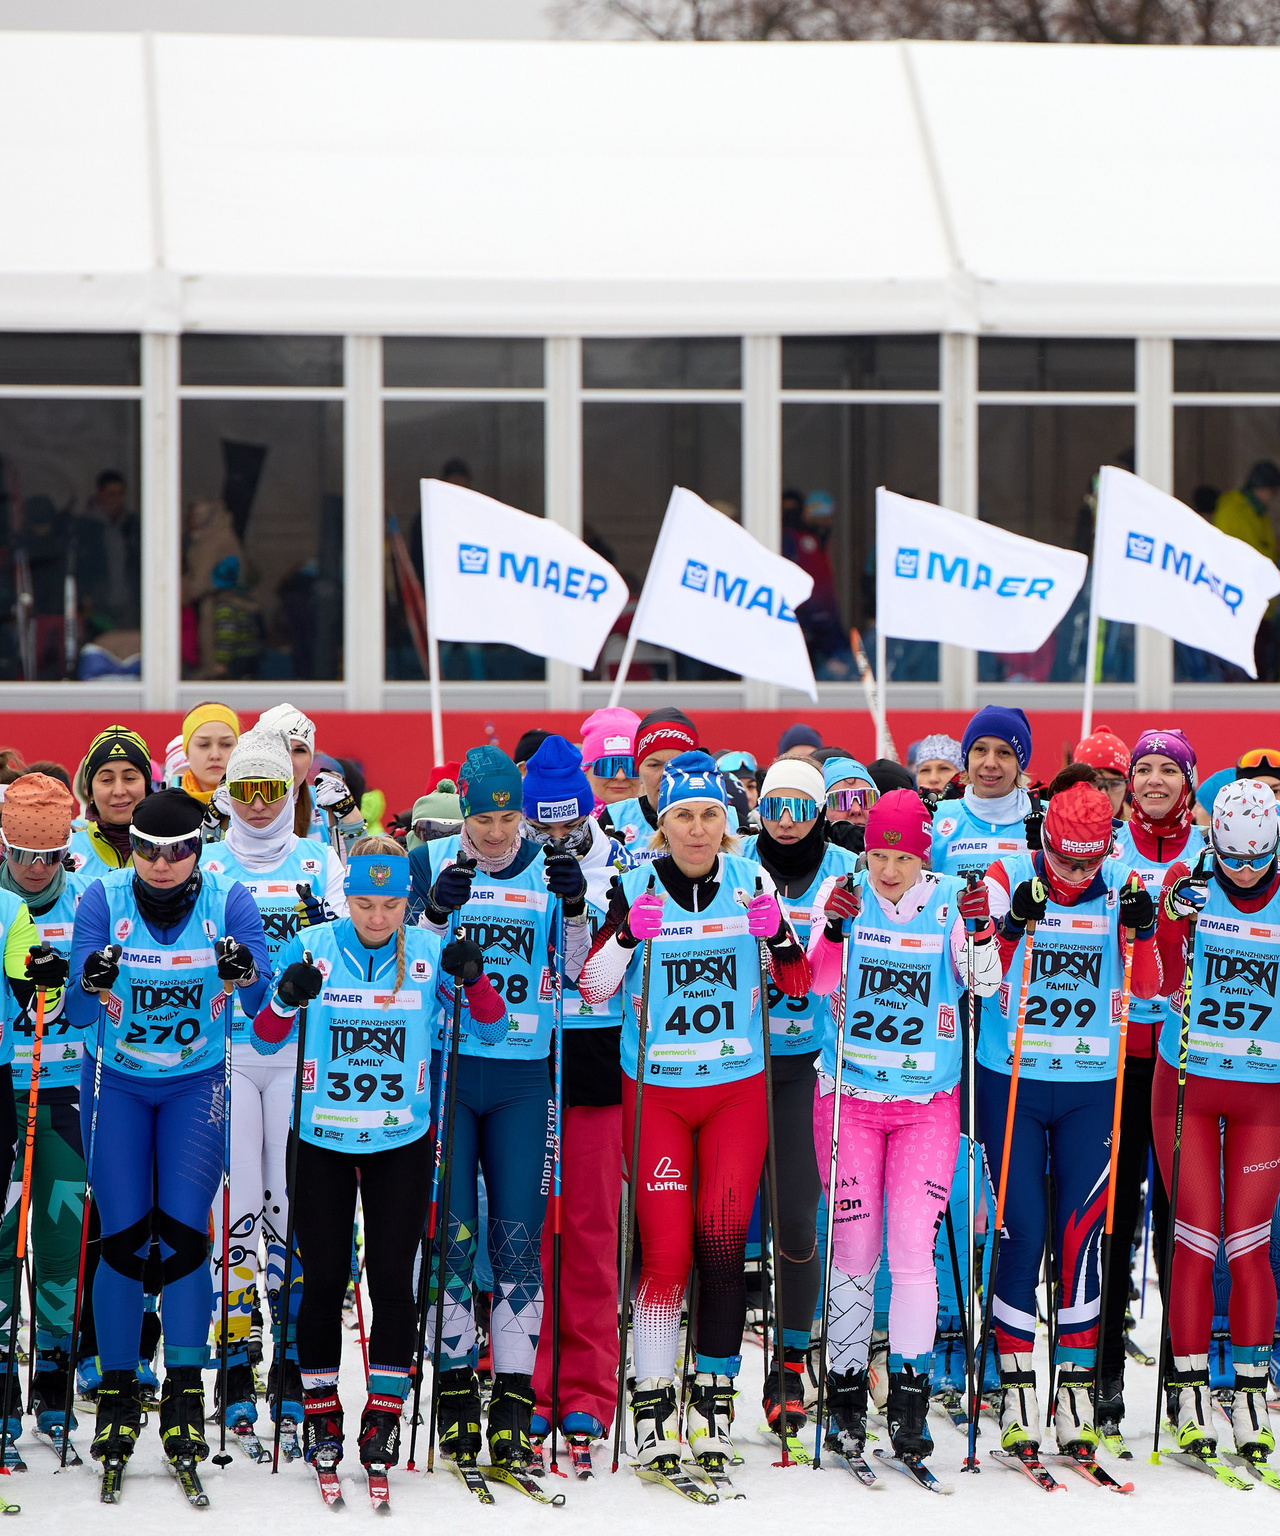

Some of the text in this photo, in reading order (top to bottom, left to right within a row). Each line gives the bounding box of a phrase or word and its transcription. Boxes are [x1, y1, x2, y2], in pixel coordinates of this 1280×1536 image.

[500, 552, 607, 602] MAER
[928, 551, 1054, 600] MAER
[714, 570, 798, 624] MAE
[552, 804, 576, 813] СПОРТ
[957, 842, 988, 851] MAER
[487, 916, 535, 926] PANZHINSKIY
[1208, 921, 1239, 933] MAER
[660, 927, 693, 936] MAER
[461, 922, 534, 965] TOPSKI
[863, 932, 891, 944] MAER
[692, 947, 736, 957] PANZHINSKIY
[1205, 945, 1220, 953] TEAM
[1234, 950, 1280, 961] PANZHINSKIY
[130, 955, 161, 963] MAER
[889, 959, 931, 970] PANZHINSKIY
[1031, 949, 1102, 988] TOPSKI
[160, 977, 204, 985] PANZHINSKIY
[662, 955, 737, 998] TOPSKI
[1203, 952, 1279, 999] TOPSKI
[859, 964, 931, 1008] TOPSKI
[1046, 982, 1079, 992] FAMILY
[1220, 986, 1253, 996] FAMILY
[130, 984, 204, 1014] TOPSKI
[330, 994, 362, 1003] MAER
[683, 988, 717, 999] FAMILY
[874, 998, 908, 1010] FAMILY
[147, 1011, 180, 1021] FAMILY
[1025, 995, 1096, 1028] 299
[1197, 998, 1272, 1032] 257
[665, 1001, 735, 1036] 401
[125, 1018, 200, 1045] 270
[850, 1011, 924, 1045] 262
[329, 1025, 406, 1063] TOPSKI
[653, 1048, 696, 1056] greenworks
[348, 1059, 384, 1067] FAMILY
[94, 1046, 103, 1100] SWIX
[327, 1072, 404, 1103] 393
[316, 1113, 358, 1123] greenworks
[1243, 1160, 1279, 1174] BOSCO
[540, 1153, 554, 1196] СПОРТ
[646, 1181, 688, 1192] Löffler
[900, 1385, 922, 1393] salomon
[504, 1391, 533, 1403] FISCHER
[305, 1400, 337, 1410] MADSHUS
